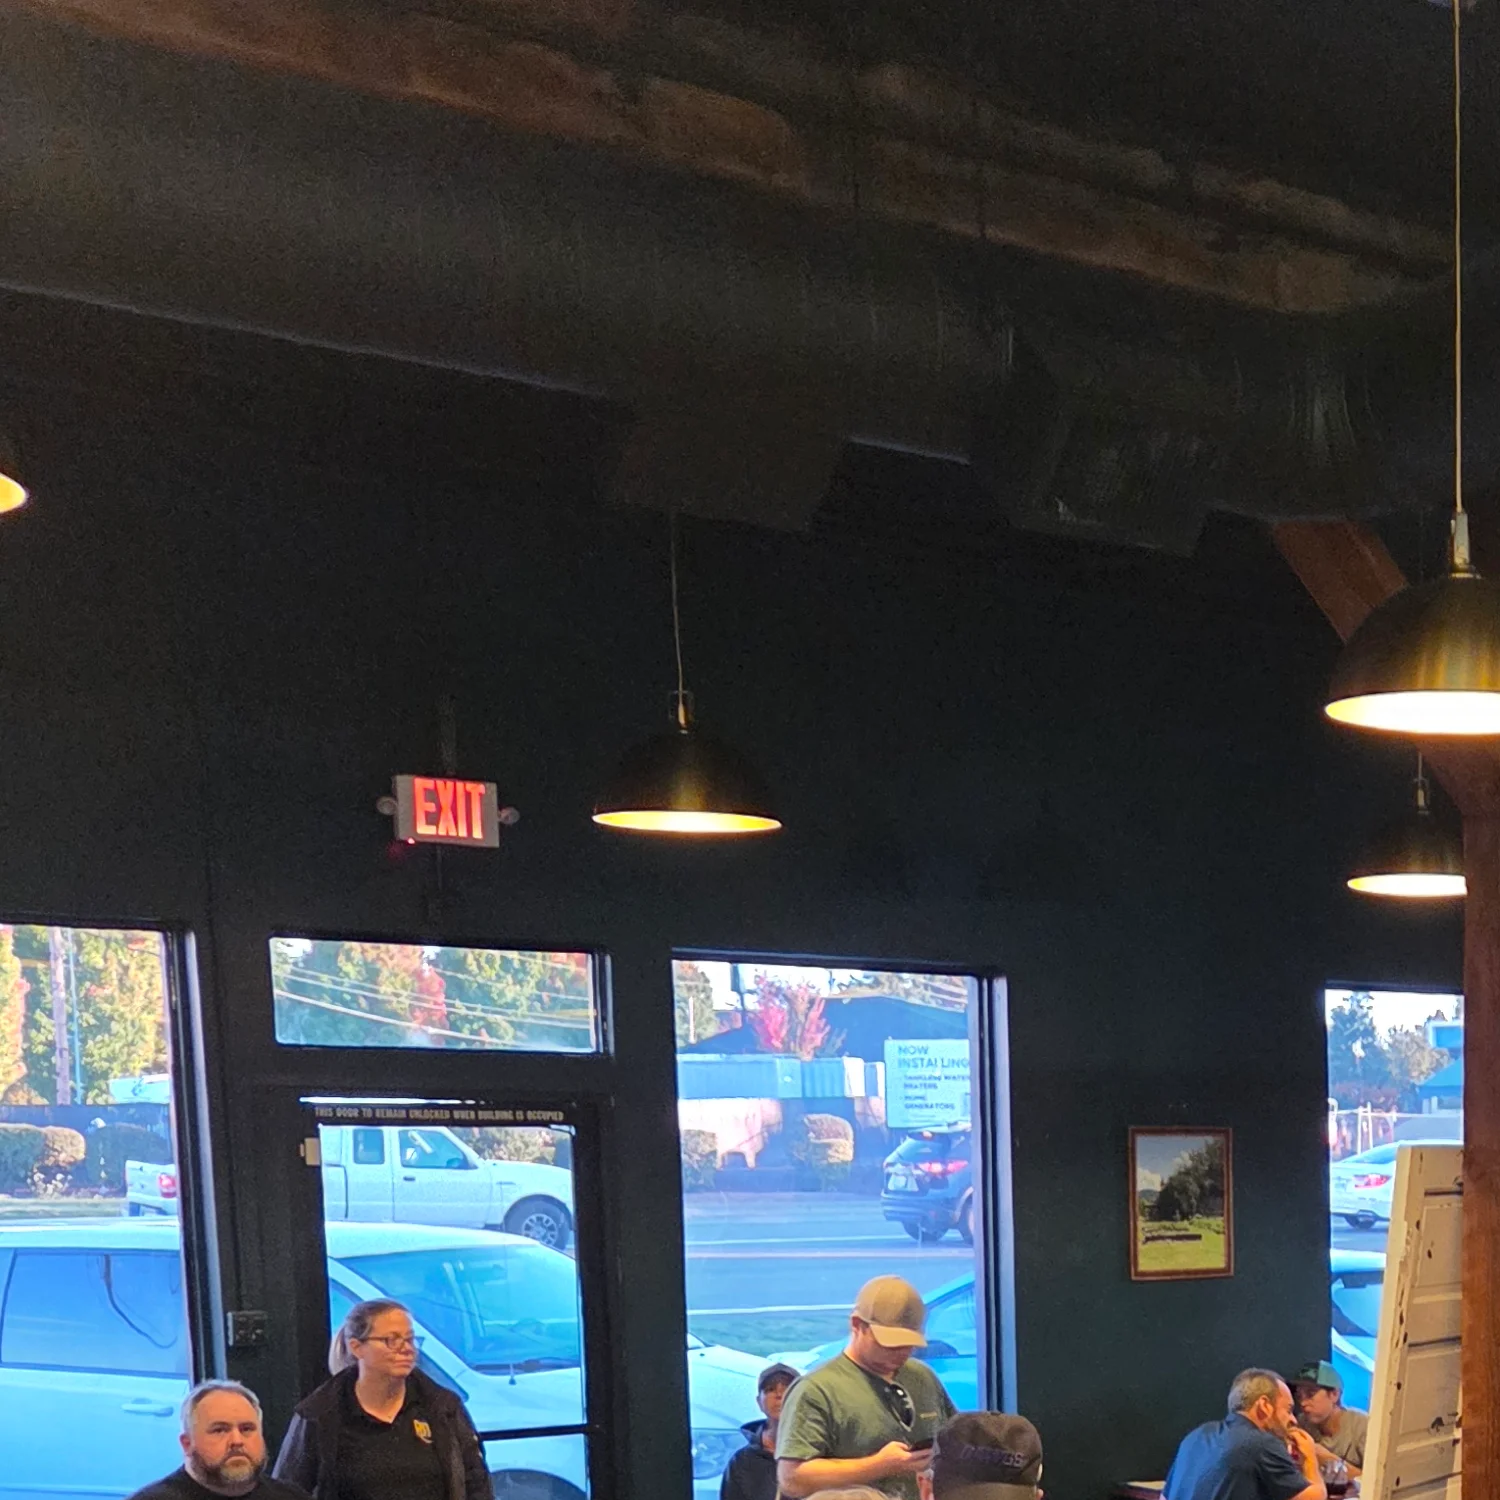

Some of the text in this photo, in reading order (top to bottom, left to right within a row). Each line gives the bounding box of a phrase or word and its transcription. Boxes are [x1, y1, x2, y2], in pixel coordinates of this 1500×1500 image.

[414, 777, 486, 839] EXIT
[898, 1045, 929, 1055] NOW
[898, 1057, 969, 1068] INSTALLING
[315, 1107, 334, 1118] THIS
[336, 1107, 359, 1118] DOOR
[361, 1107, 373, 1118] TO
[375, 1108, 407, 1118] REMAIN
[453, 1110, 475, 1120] WHEN
[515, 1110, 524, 1120] IS
[527, 1110, 564, 1121] OCCUPIED
